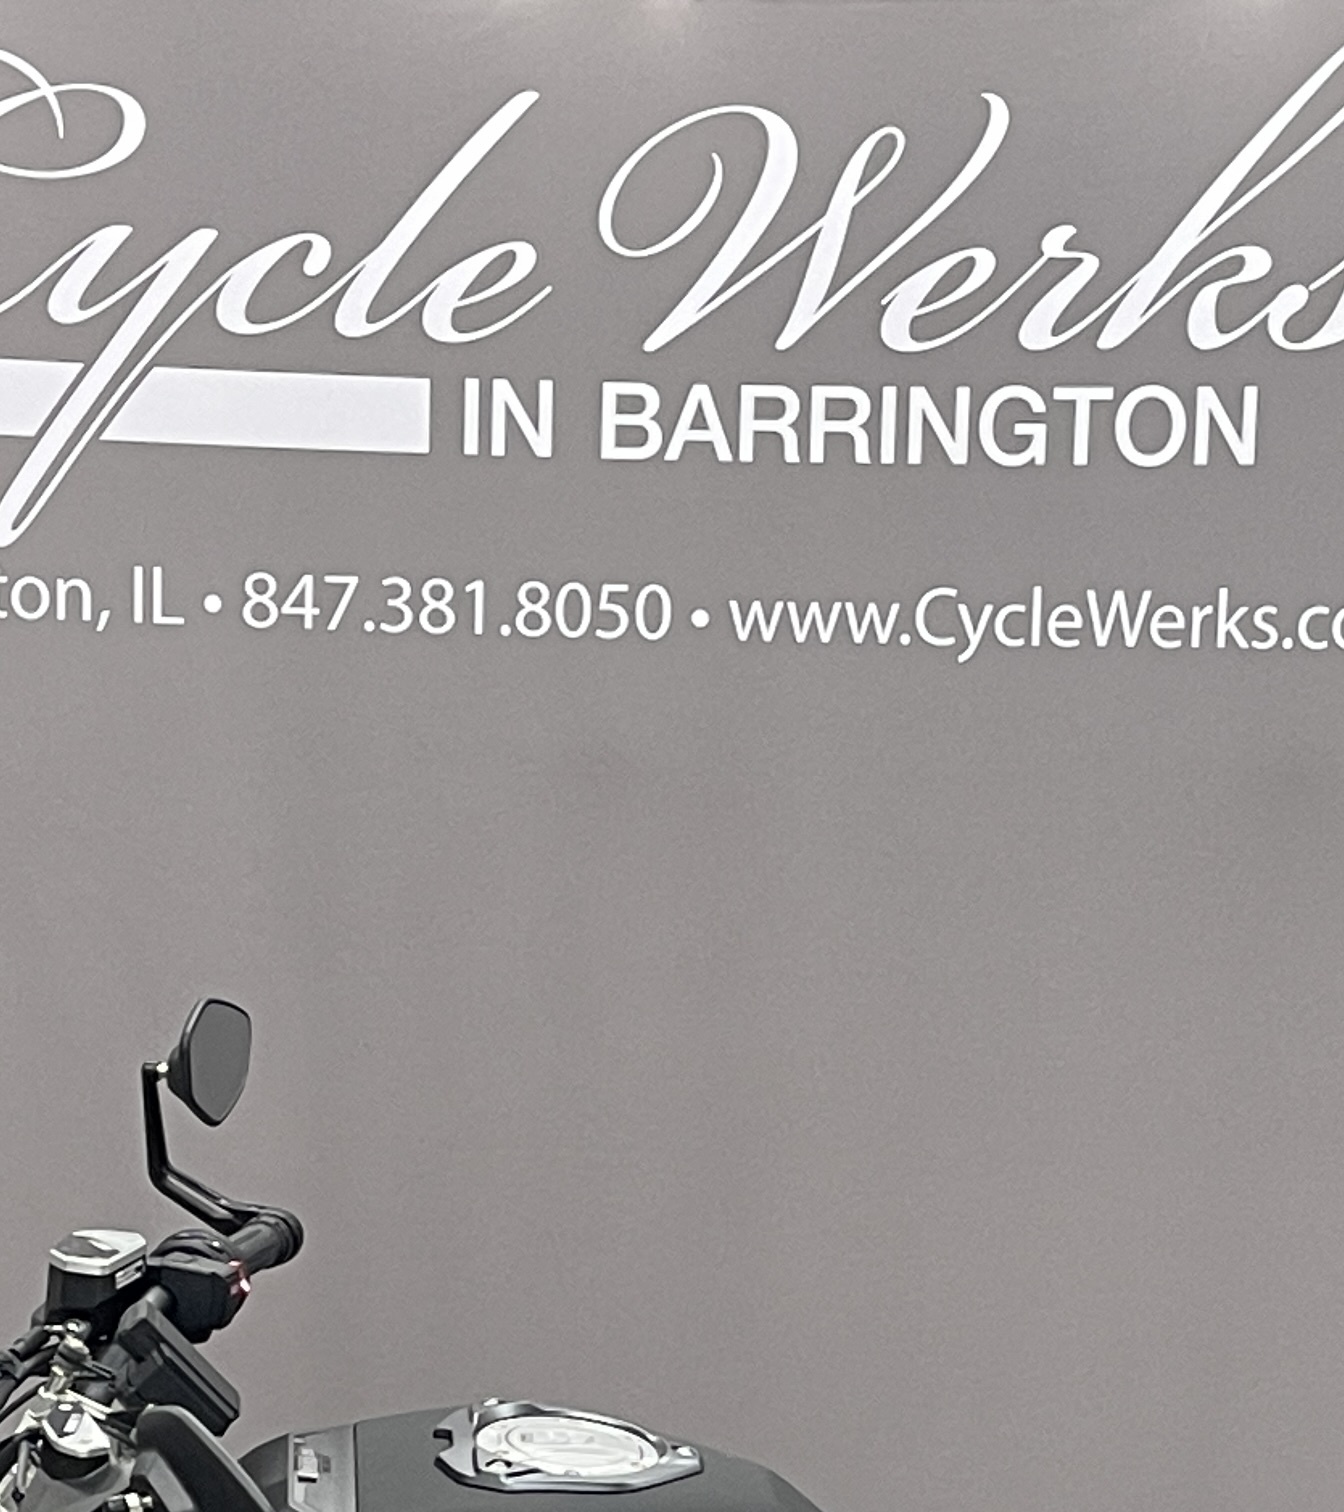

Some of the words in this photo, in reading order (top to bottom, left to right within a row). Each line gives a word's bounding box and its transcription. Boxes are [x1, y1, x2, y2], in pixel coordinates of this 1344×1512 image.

[462, 377, 554, 459] IN
[599, 380, 1259, 468] BARRINGTON
[132, 565, 185, 625] IL
[241, 570, 672, 640] 847.381.8050
